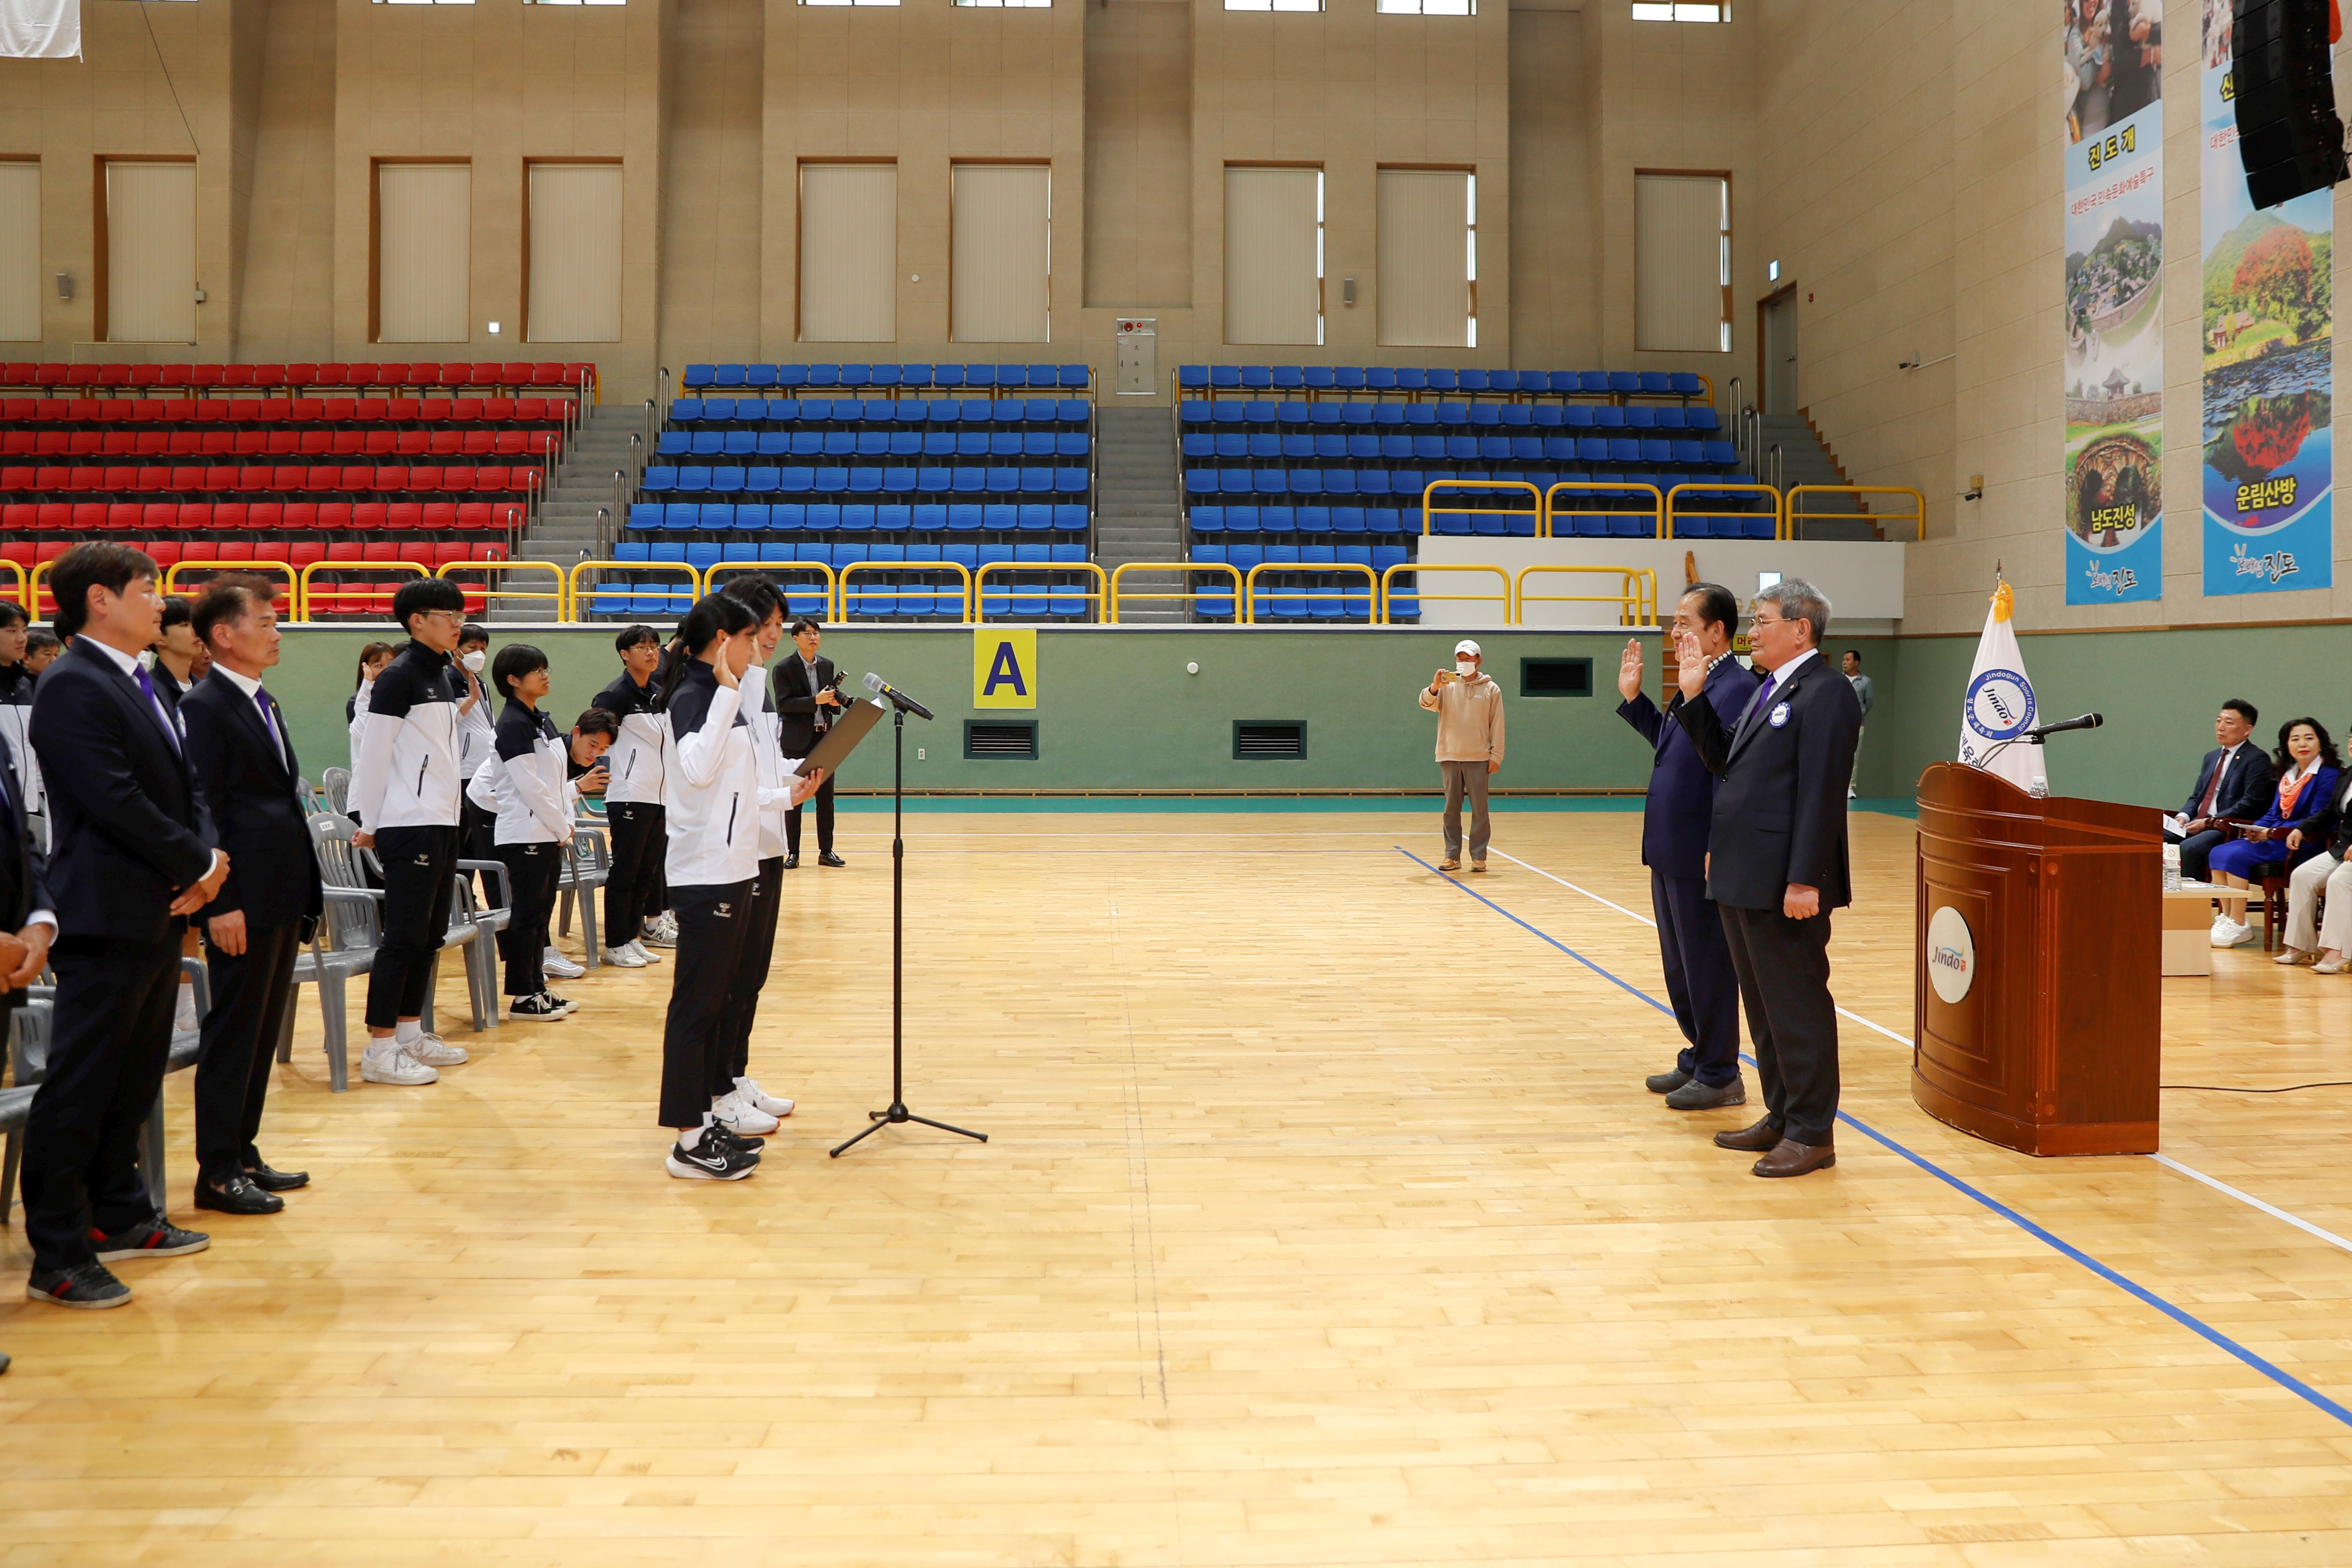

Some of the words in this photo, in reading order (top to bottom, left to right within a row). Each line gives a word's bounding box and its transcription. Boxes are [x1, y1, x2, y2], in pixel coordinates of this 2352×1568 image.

[2071, 194, 2096, 215] 대한민국
[2098, 167, 2154, 205] 민속문화예술특구
[2235, 475, 2297, 512] 운림산방
[2091, 503, 2136, 533] 남도진성
[983, 642, 1027, 696] A
[1985, 672, 2019, 682] Jindogun
[1983, 688, 2007, 719] Jindo
[2019, 681, 2033, 705] Sports
[2018, 707, 2034, 731] Council
[1932, 946, 1960, 970] Jindo
